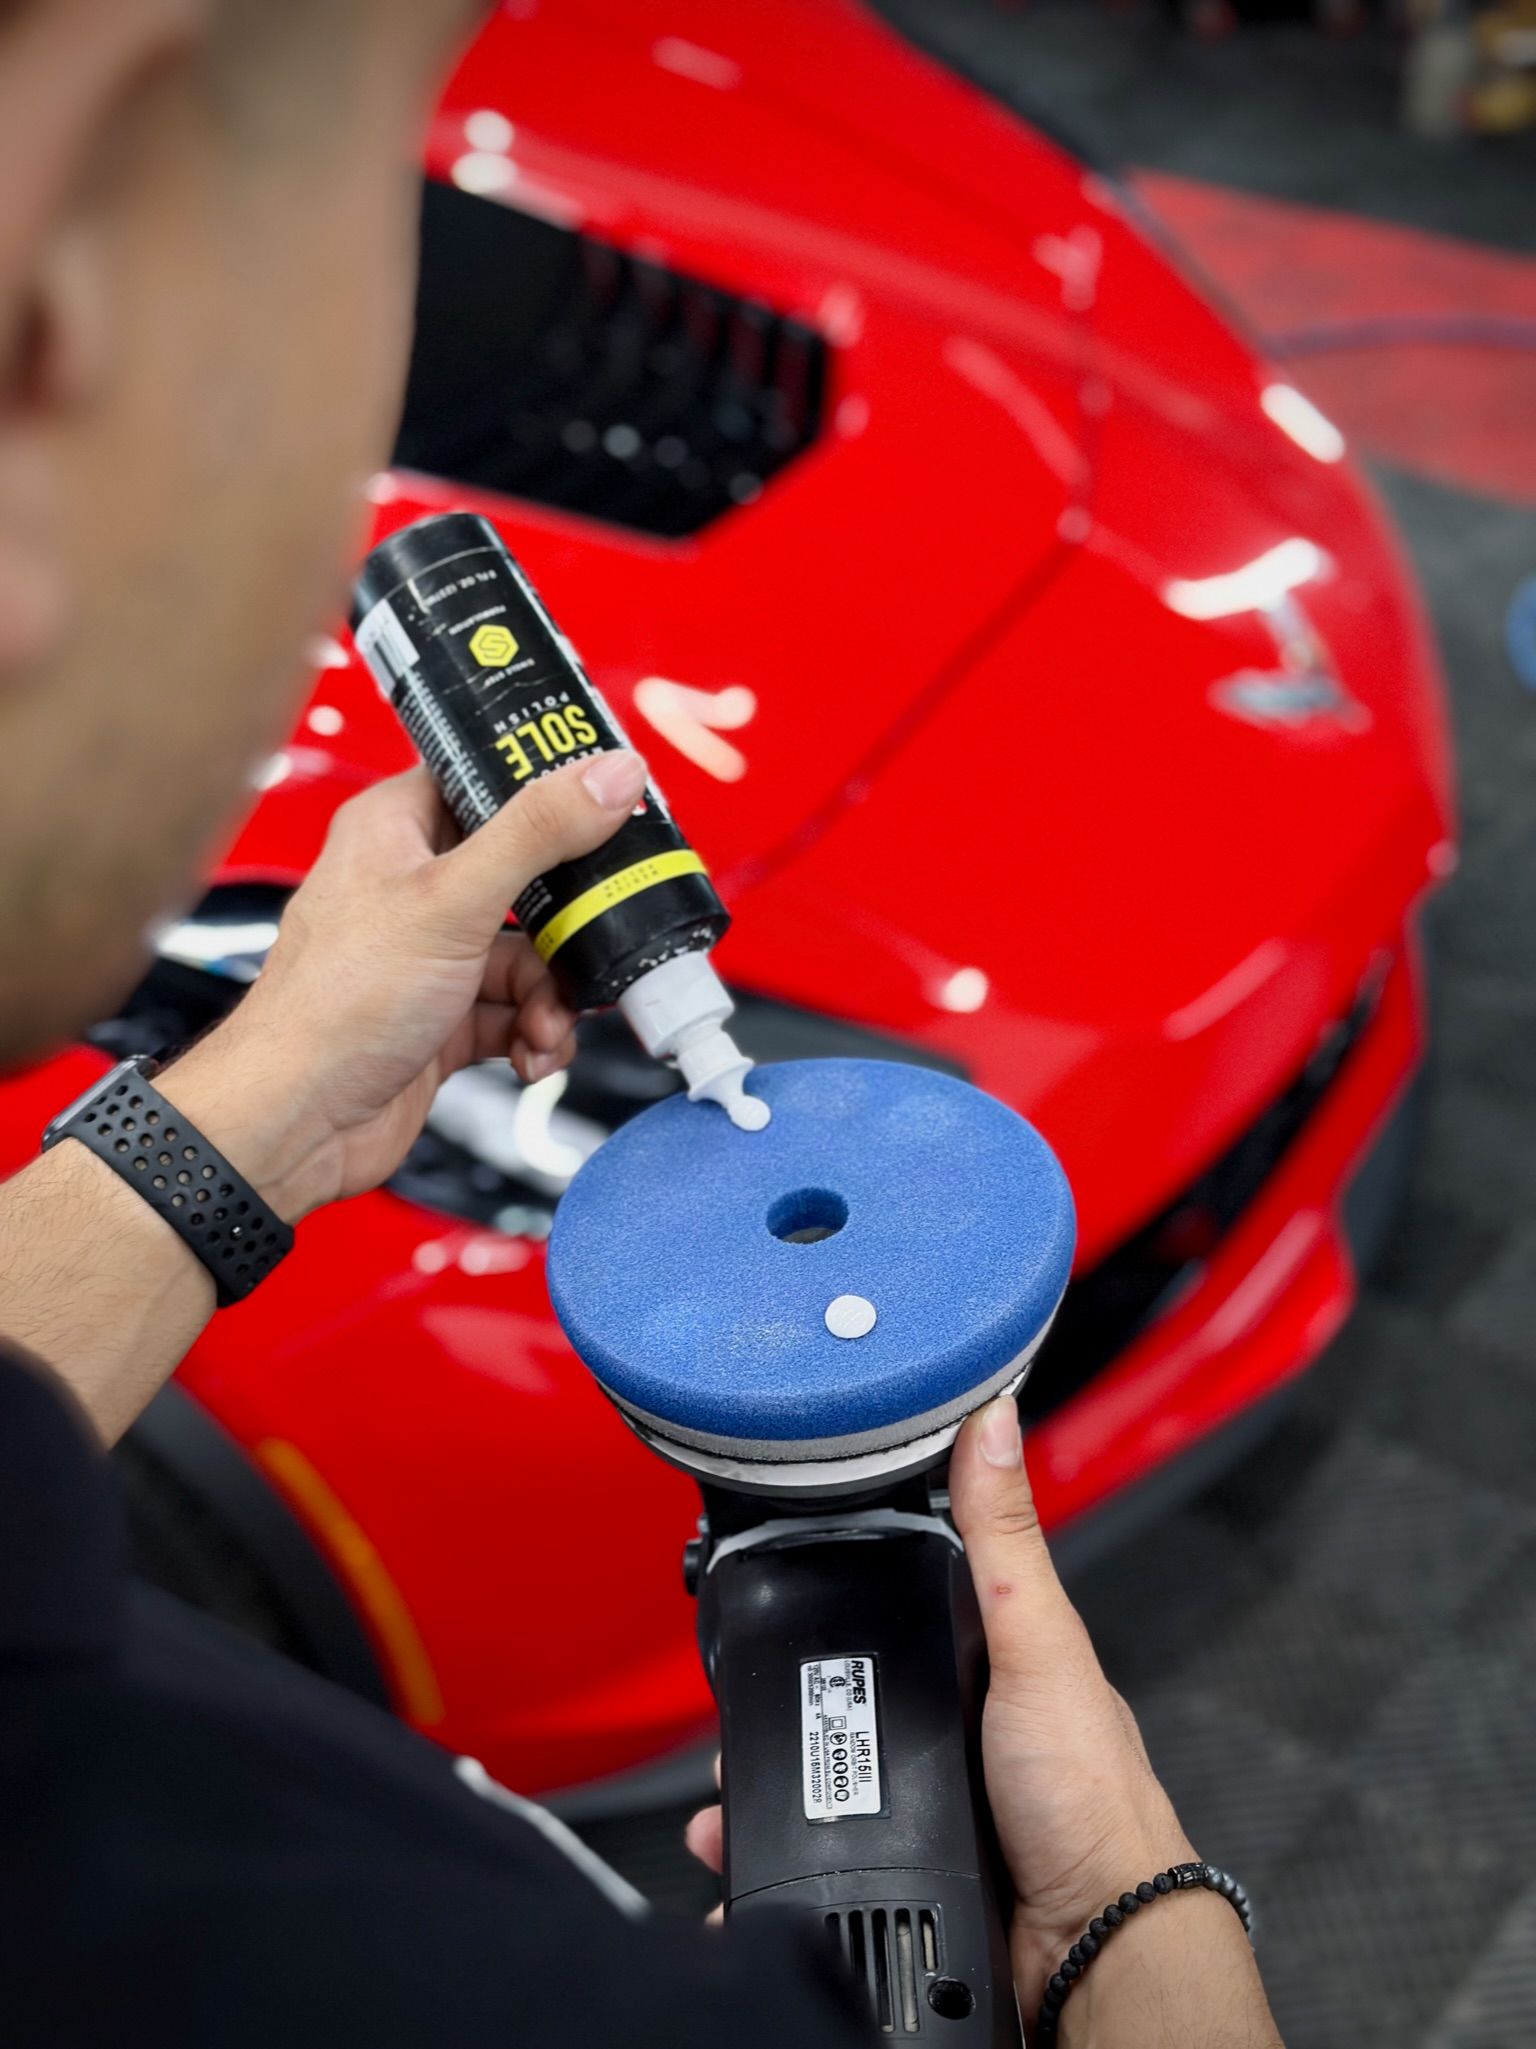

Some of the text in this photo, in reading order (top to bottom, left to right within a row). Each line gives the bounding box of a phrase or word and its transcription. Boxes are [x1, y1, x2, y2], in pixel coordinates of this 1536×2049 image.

[493, 692, 569, 733] POLISH
[494, 704, 597, 780] SOLE
[851, 1660, 866, 1704] RUPES
[855, 1730, 872, 1783] LHR15III
